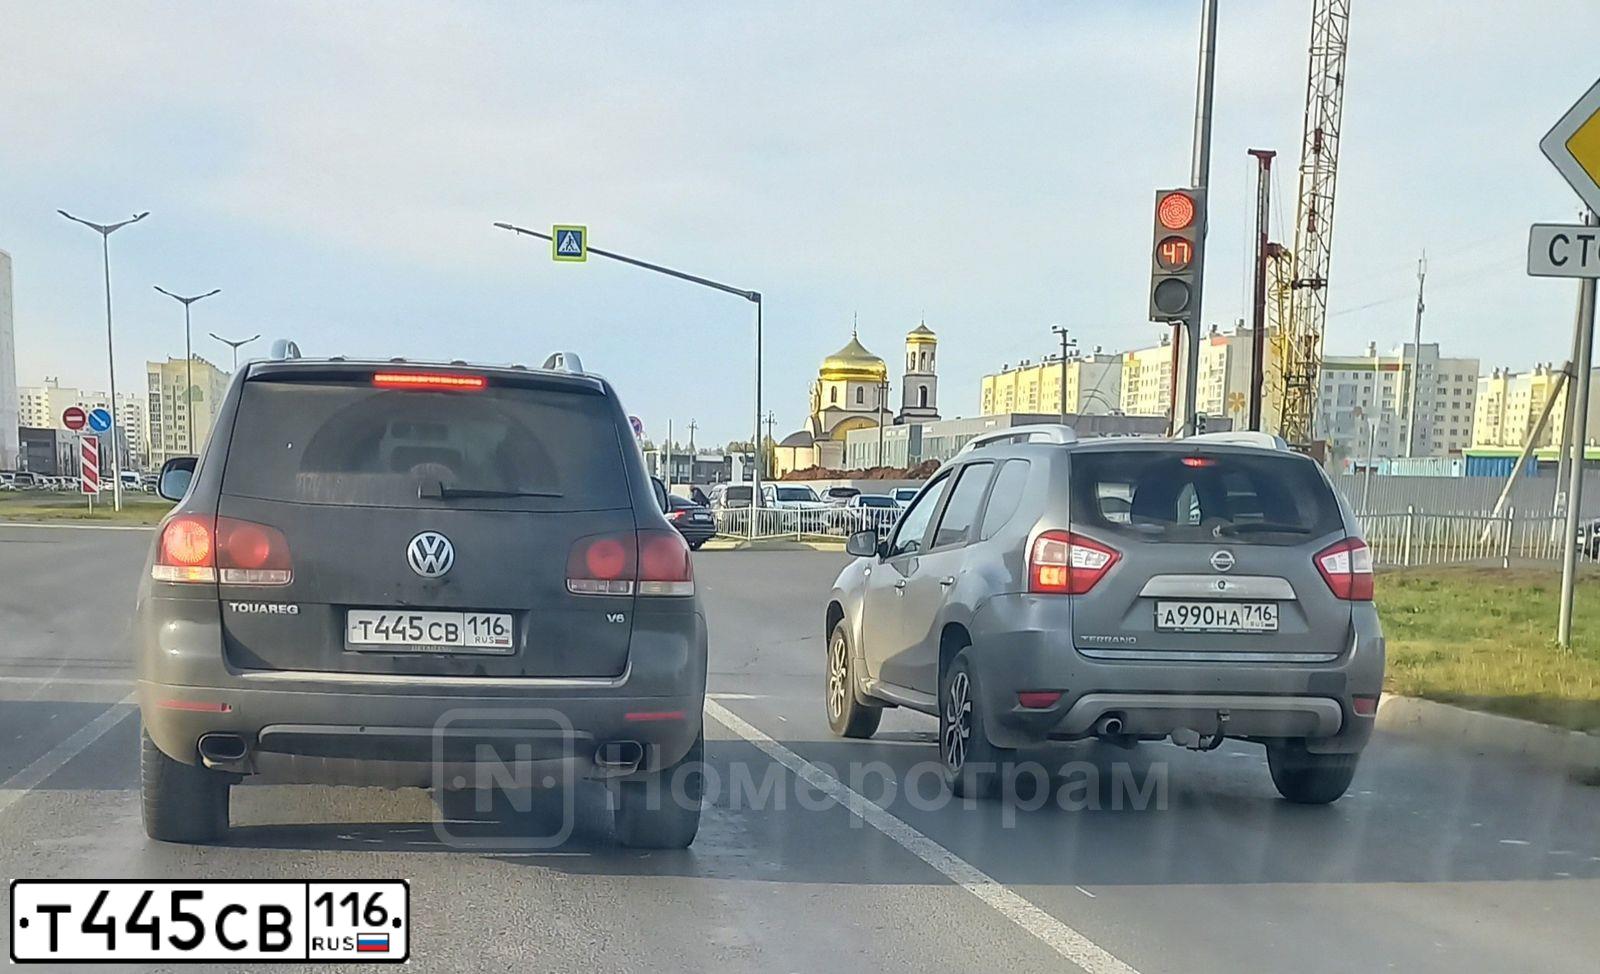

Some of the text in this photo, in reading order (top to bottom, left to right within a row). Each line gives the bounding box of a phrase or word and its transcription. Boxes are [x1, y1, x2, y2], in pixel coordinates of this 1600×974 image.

[1163, 242, 1188, 265] 47
[1548, 233, 1600, 267] СТ
[228, 602, 299, 615] TOUAREG
[1243, 605, 1272, 621] 716
[467, 616, 505, 637] 116
[474, 636, 494, 644] RUS
[1080, 635, 1137, 645] TERRANO
